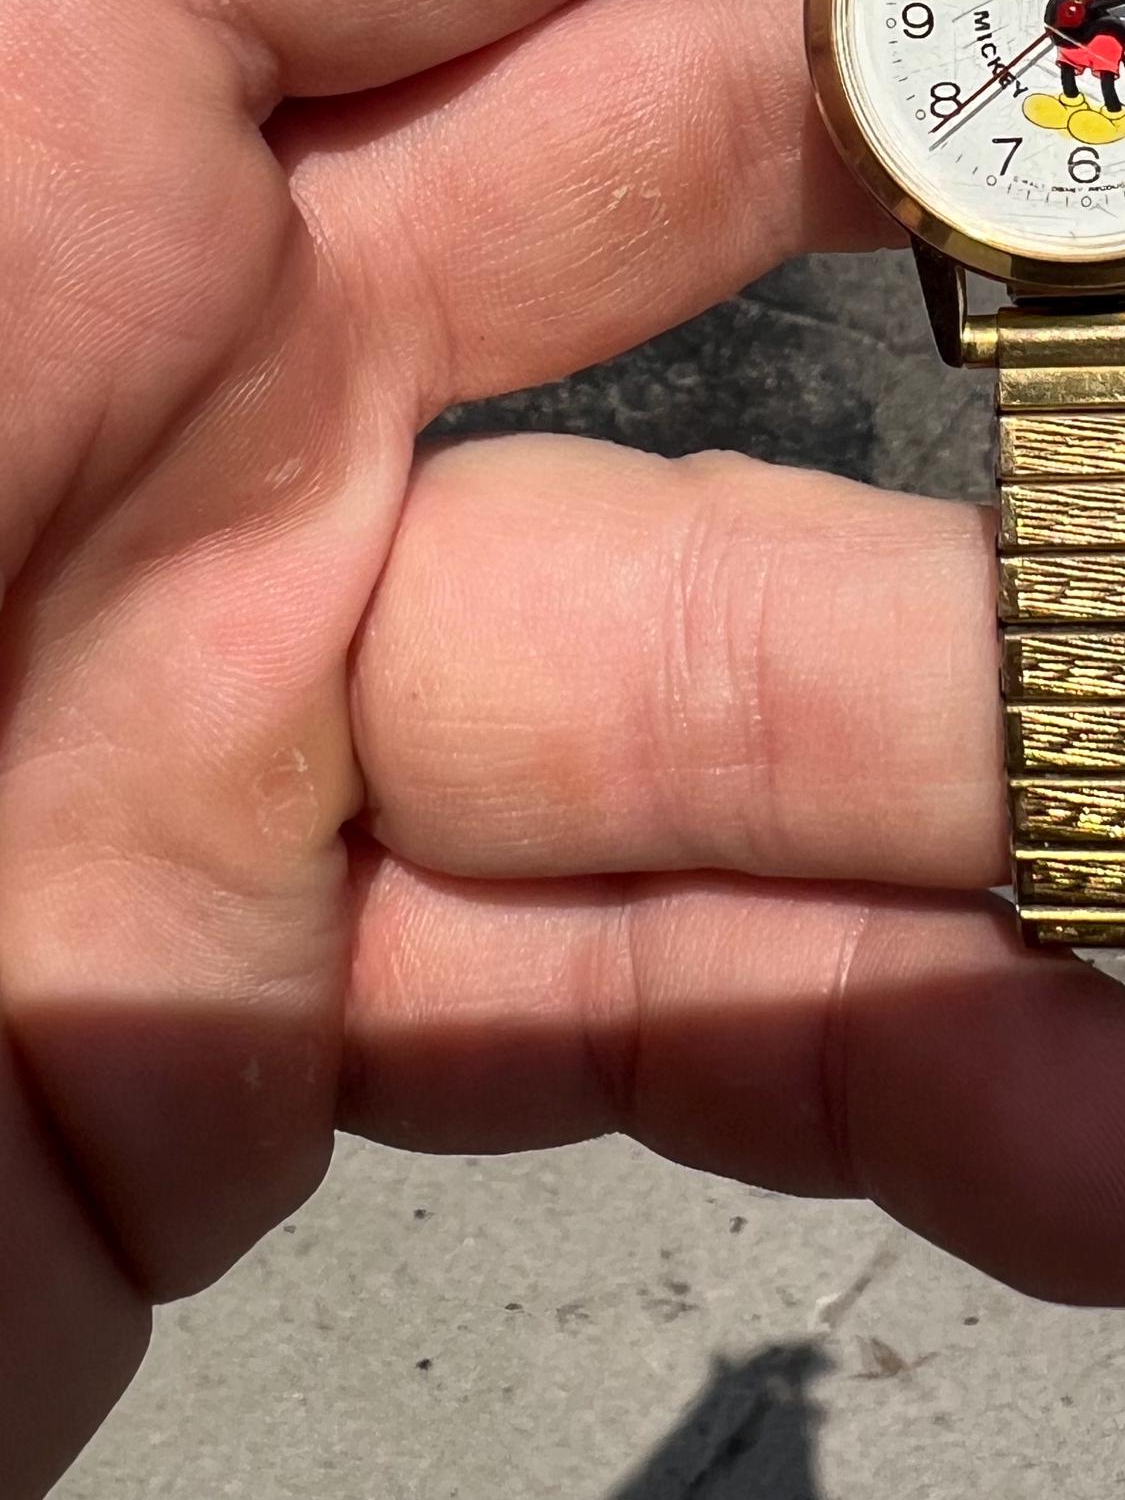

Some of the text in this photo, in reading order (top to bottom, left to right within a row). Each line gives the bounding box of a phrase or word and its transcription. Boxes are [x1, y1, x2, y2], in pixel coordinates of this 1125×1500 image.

[902, 2, 934, 39] 9
[973, 10, 1029, 99] MICKEY
[930, 82, 962, 119] 8
[992, 137, 1023, 176] 7
[1068, 146, 1100, 183] 6
